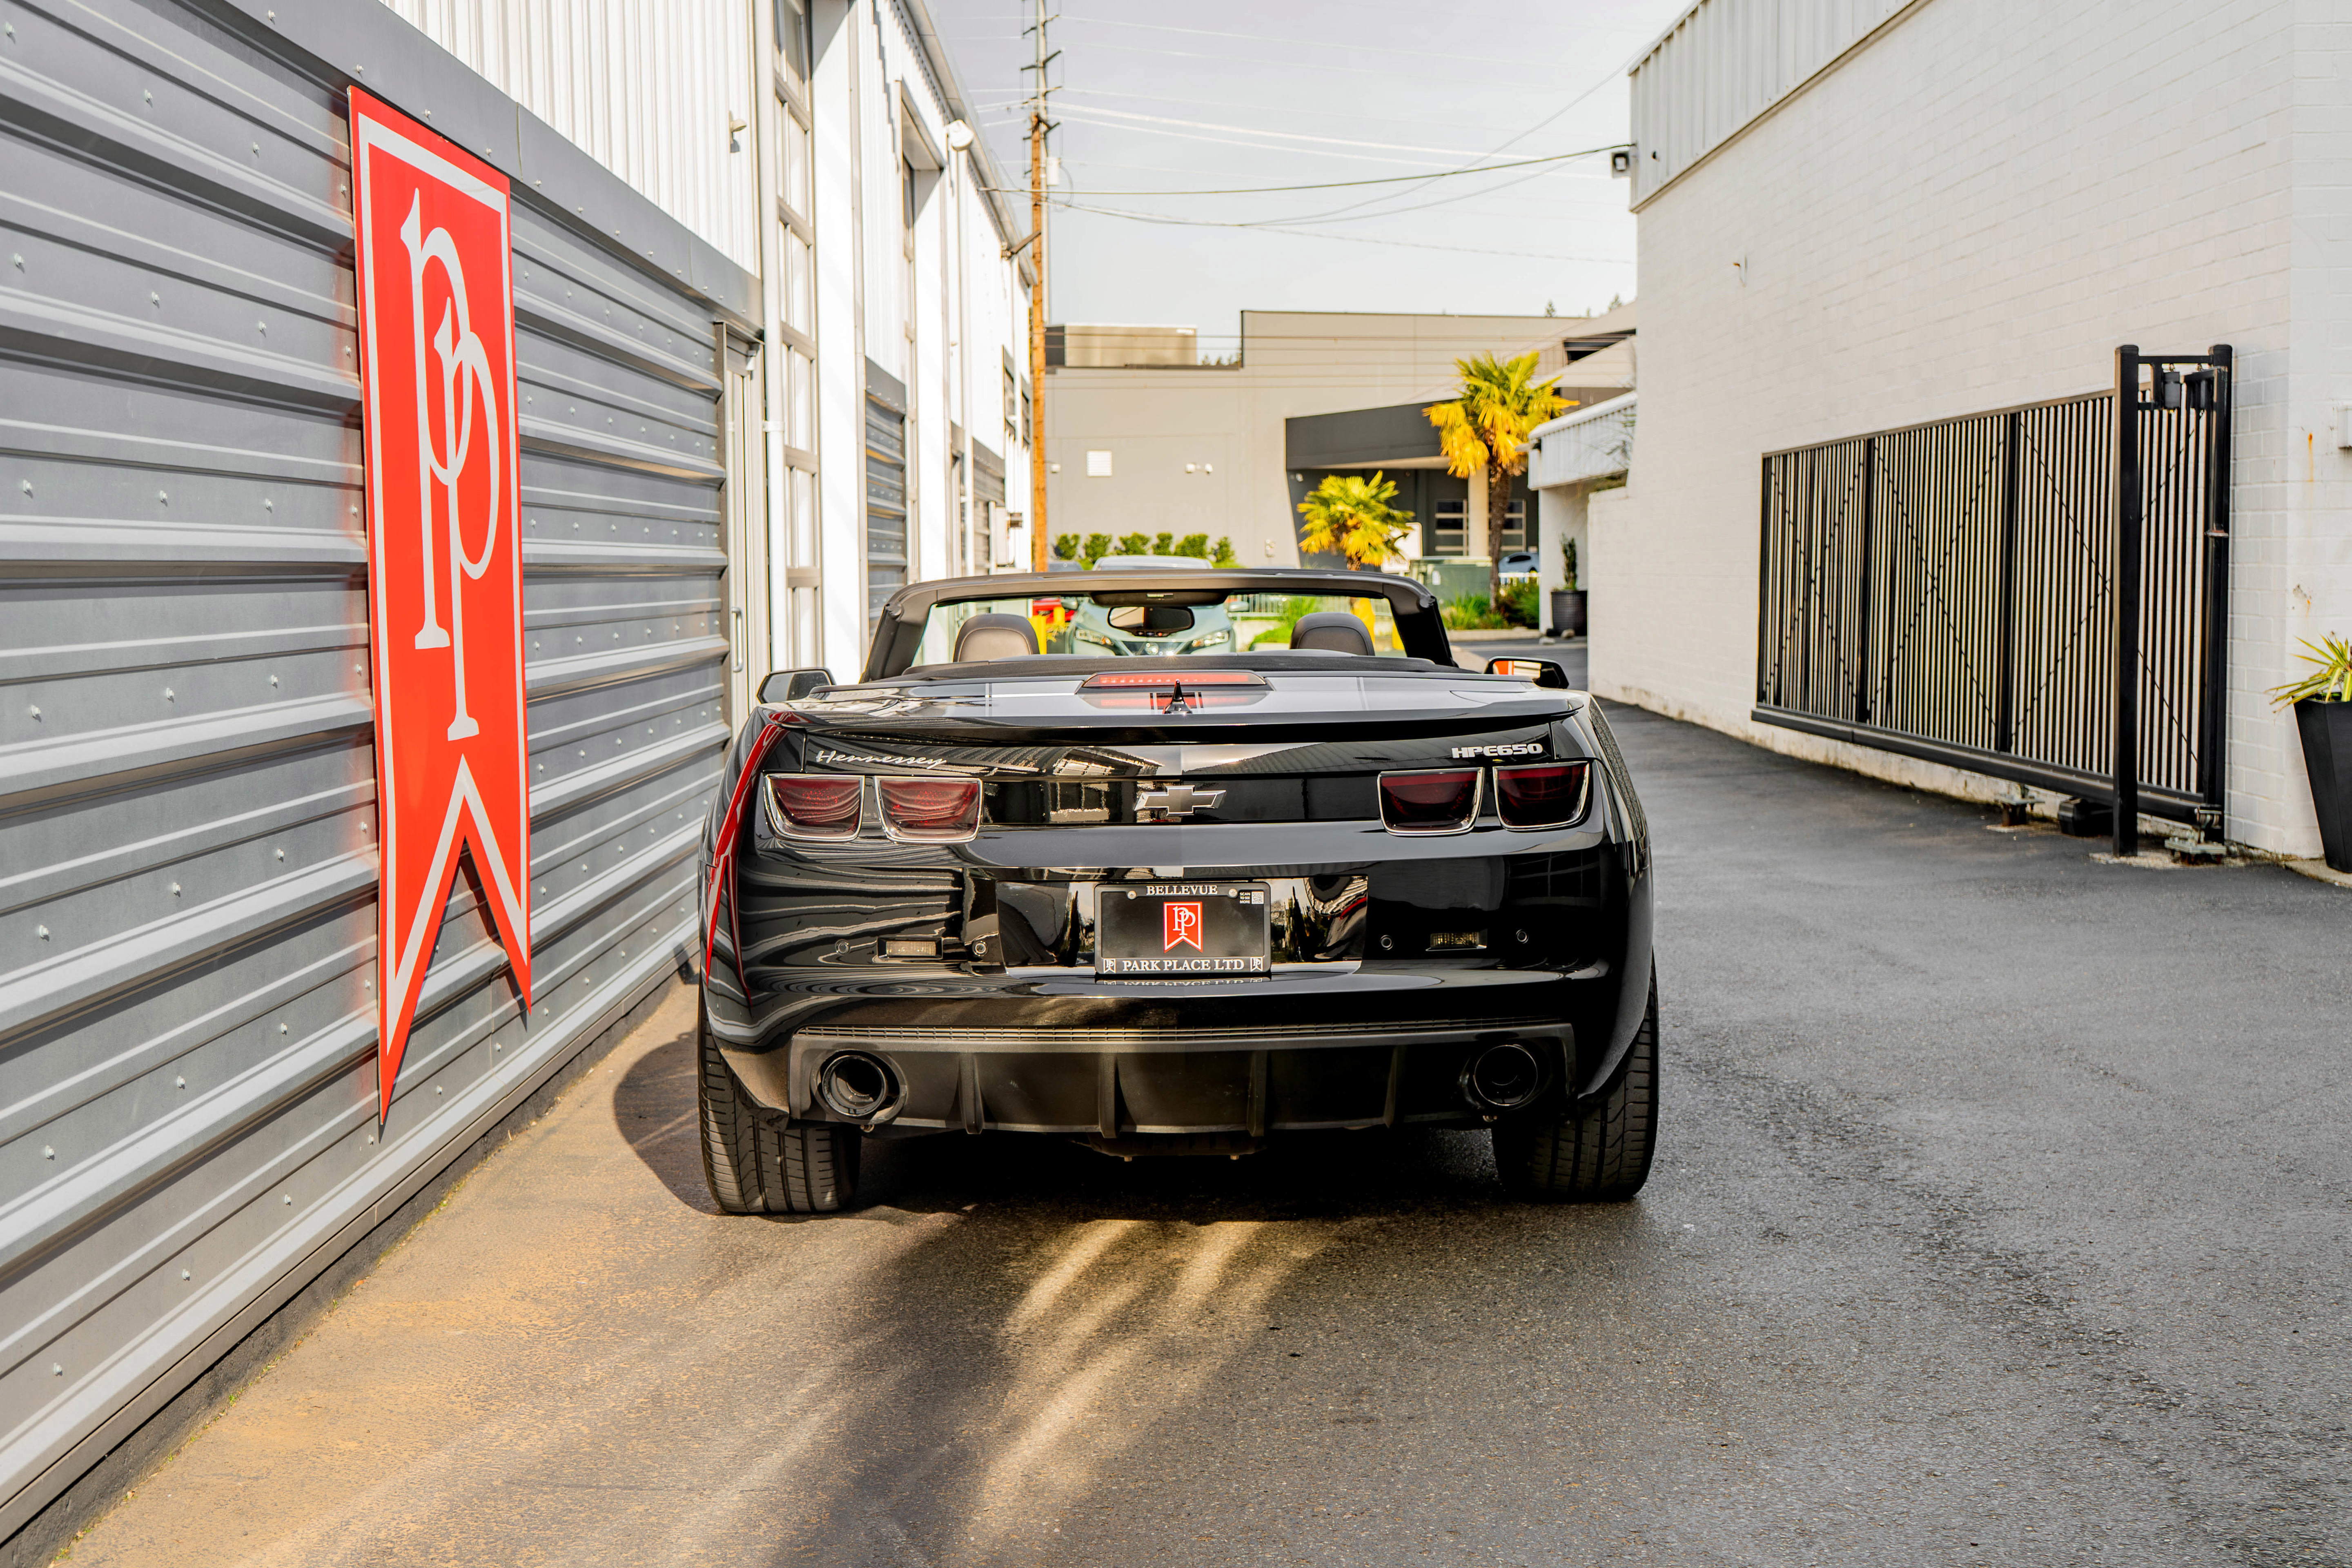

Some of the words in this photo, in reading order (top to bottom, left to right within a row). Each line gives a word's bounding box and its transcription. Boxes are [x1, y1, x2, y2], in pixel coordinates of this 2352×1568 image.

[1451, 743, 1544, 759] HPE650
[815, 750, 947, 769] Hennessey
[1146, 884, 1218, 895] BELLEVUE
[1122, 960, 1161, 972] PARK
[1163, 959, 1211, 971] PLACE
[1214, 959, 1245, 970] LTD
